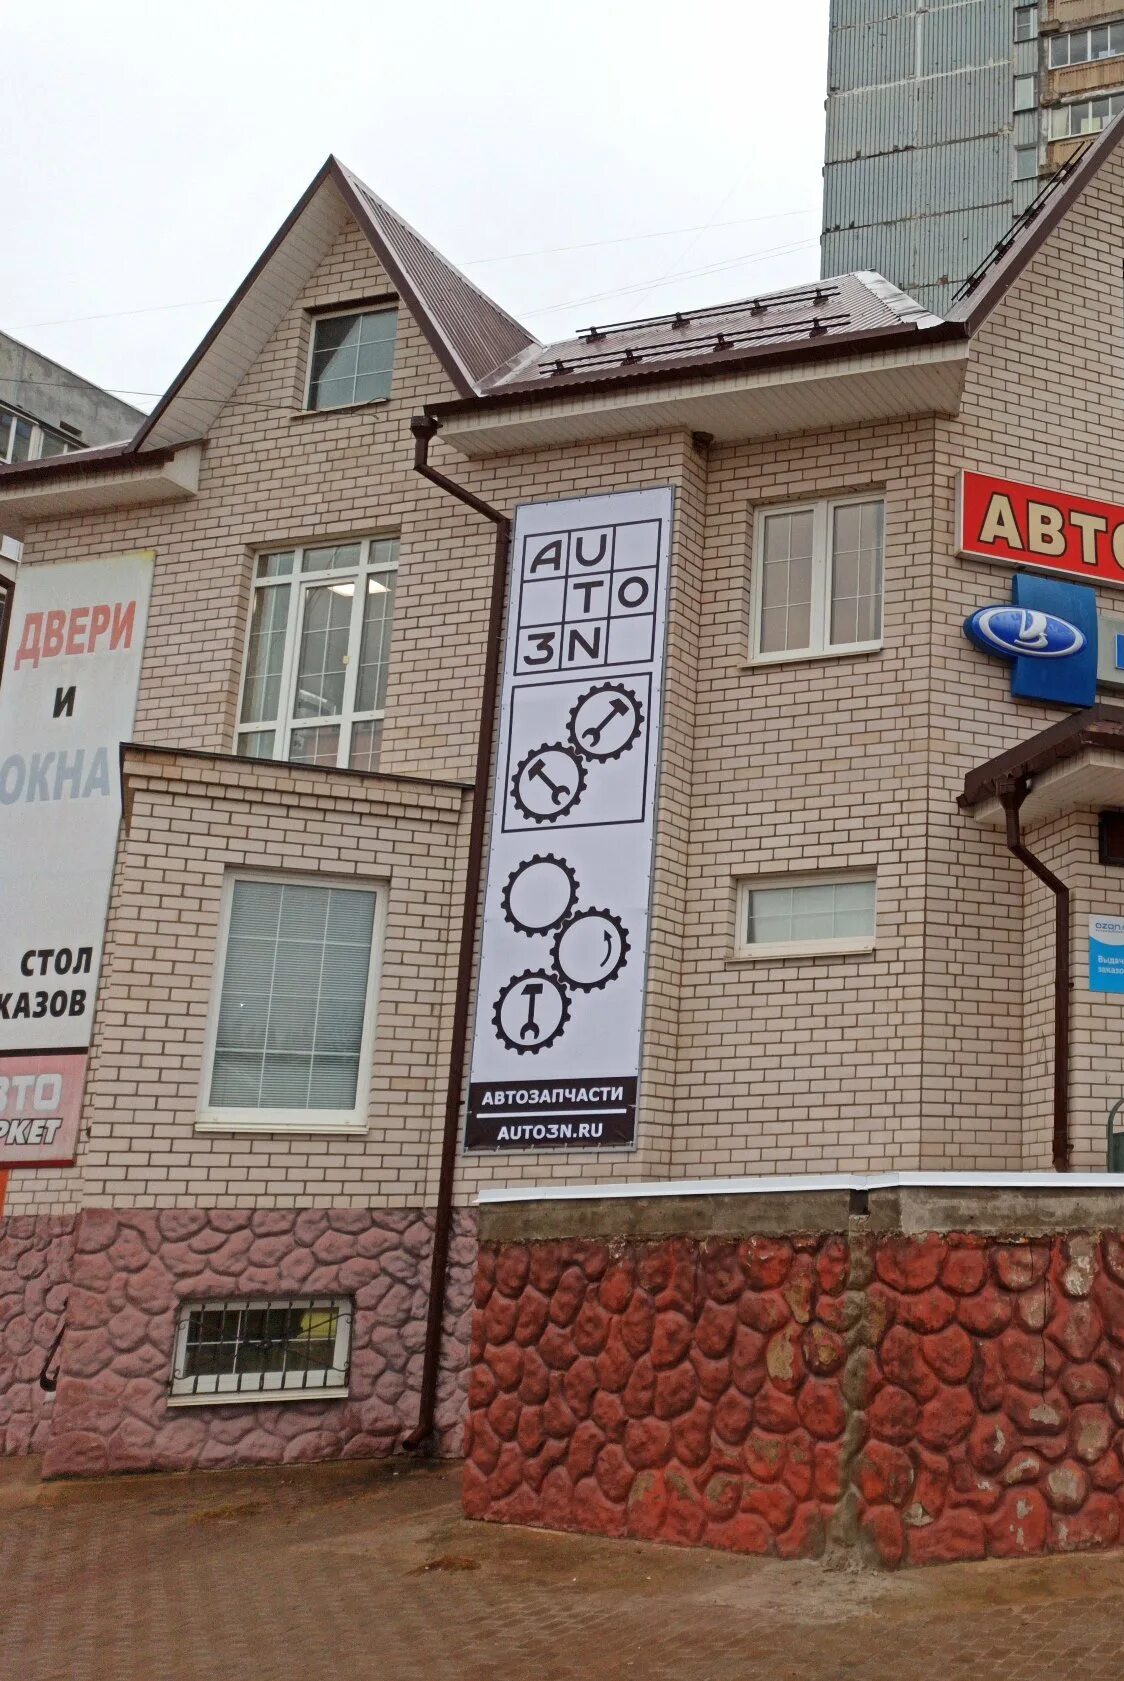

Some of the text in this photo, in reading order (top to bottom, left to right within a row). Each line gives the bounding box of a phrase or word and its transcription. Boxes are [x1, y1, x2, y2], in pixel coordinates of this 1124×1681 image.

[14, 601, 136, 671] ДВЕРИ
[53, 686, 76, 718] И
[0, 747, 110, 805] ОКНА
[21, 947, 93, 977] СТОЛ
[482, 1087, 624, 1105] АВТОЗАПЧАСТИ
[497, 1123, 603, 1140] AUTO3N.RU
